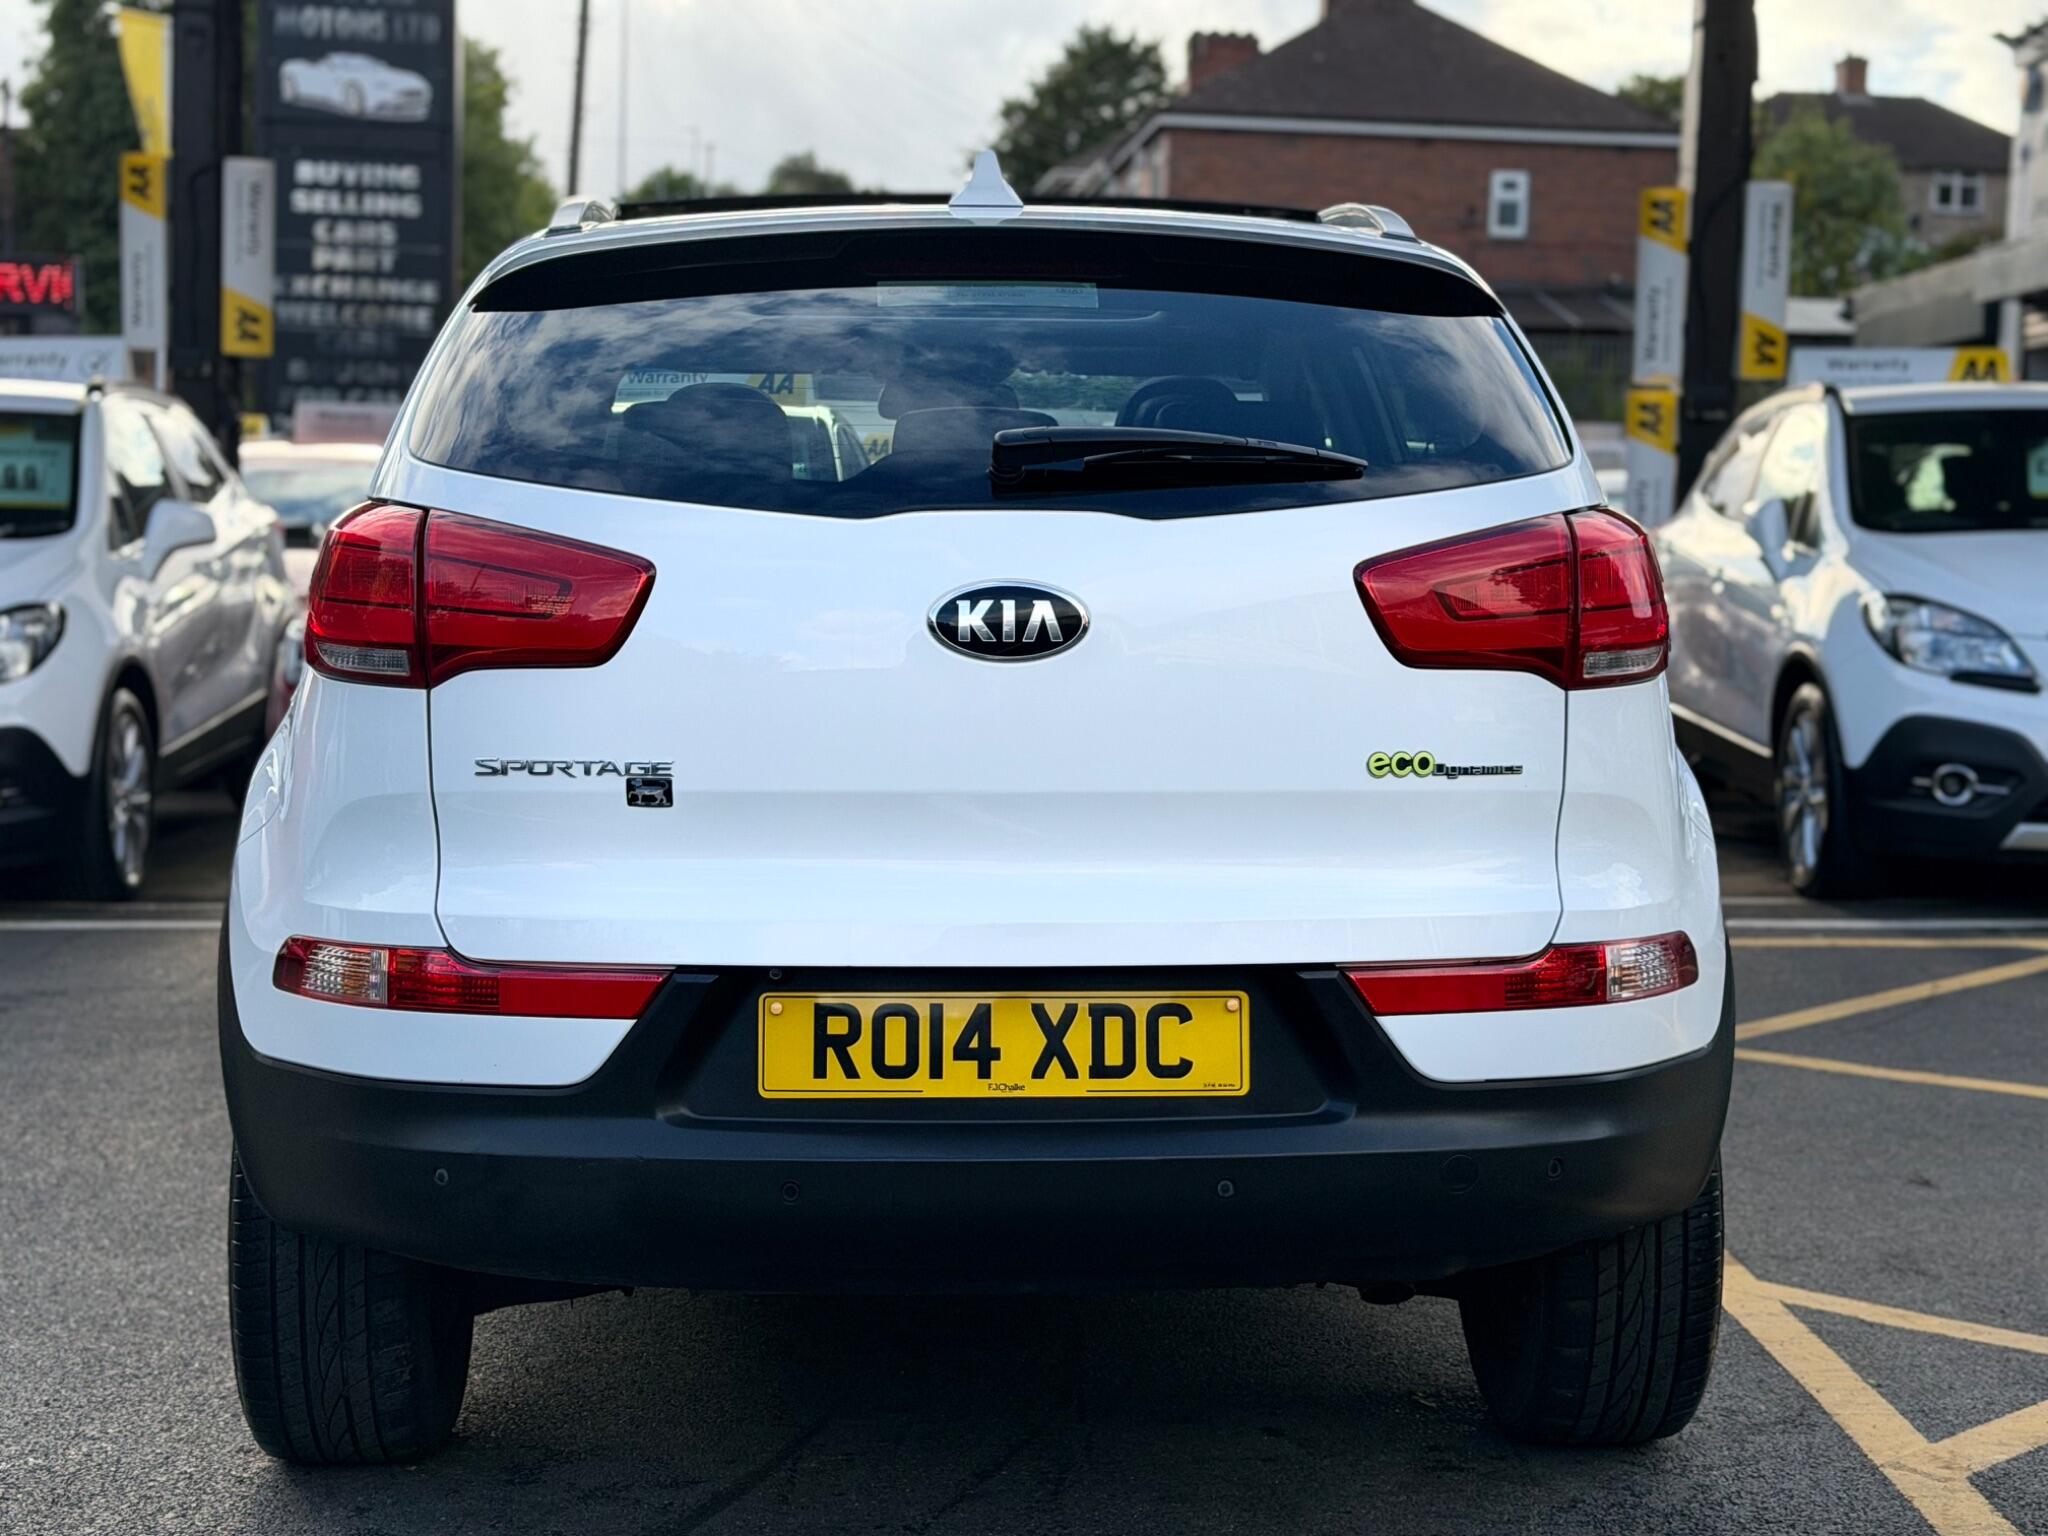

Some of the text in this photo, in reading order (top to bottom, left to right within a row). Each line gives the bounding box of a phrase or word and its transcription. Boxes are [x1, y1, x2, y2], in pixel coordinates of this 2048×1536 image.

[294, 160, 421, 190] BUYING
[289, 188, 422, 218] SELLING
[312, 218, 398, 245] CARS
[1650, 200, 1674, 235] AA
[312, 246, 396, 272] PART
[758, 373, 794, 395] AA
[866, 438, 890, 456] AA
[955, 599, 1064, 643] KIA
[474, 758, 676, 778] SPORTAGE
[812, 1001, 1194, 1080] RO14 XDC
